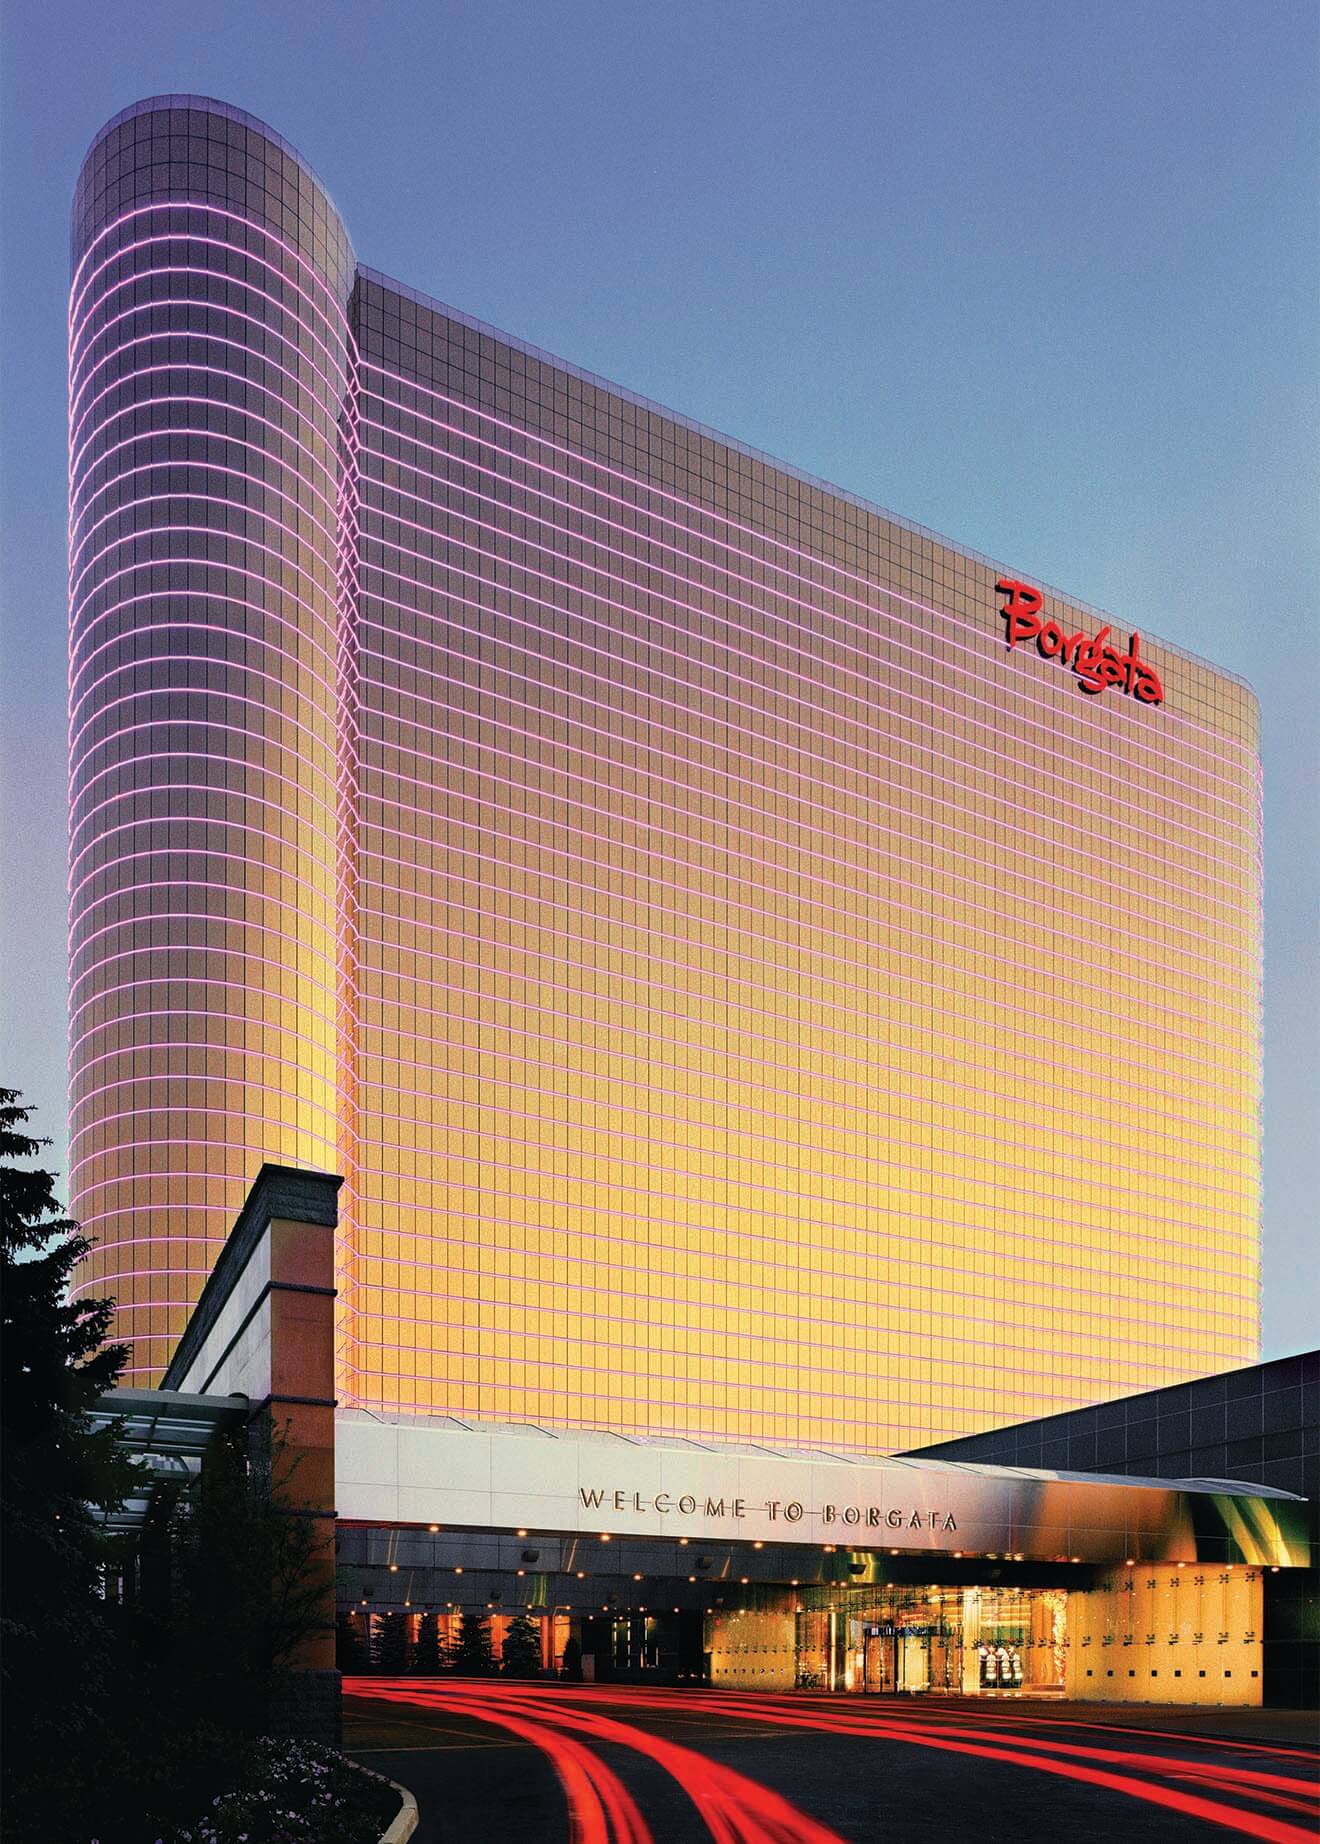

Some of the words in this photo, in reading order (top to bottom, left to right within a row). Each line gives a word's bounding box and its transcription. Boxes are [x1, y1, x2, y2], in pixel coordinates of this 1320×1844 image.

[995, 578, 1164, 705] Borgata
[579, 1487, 746, 1518] WELCOME
[765, 1500, 804, 1523] TO
[822, 1503, 958, 1533] BORGATA
